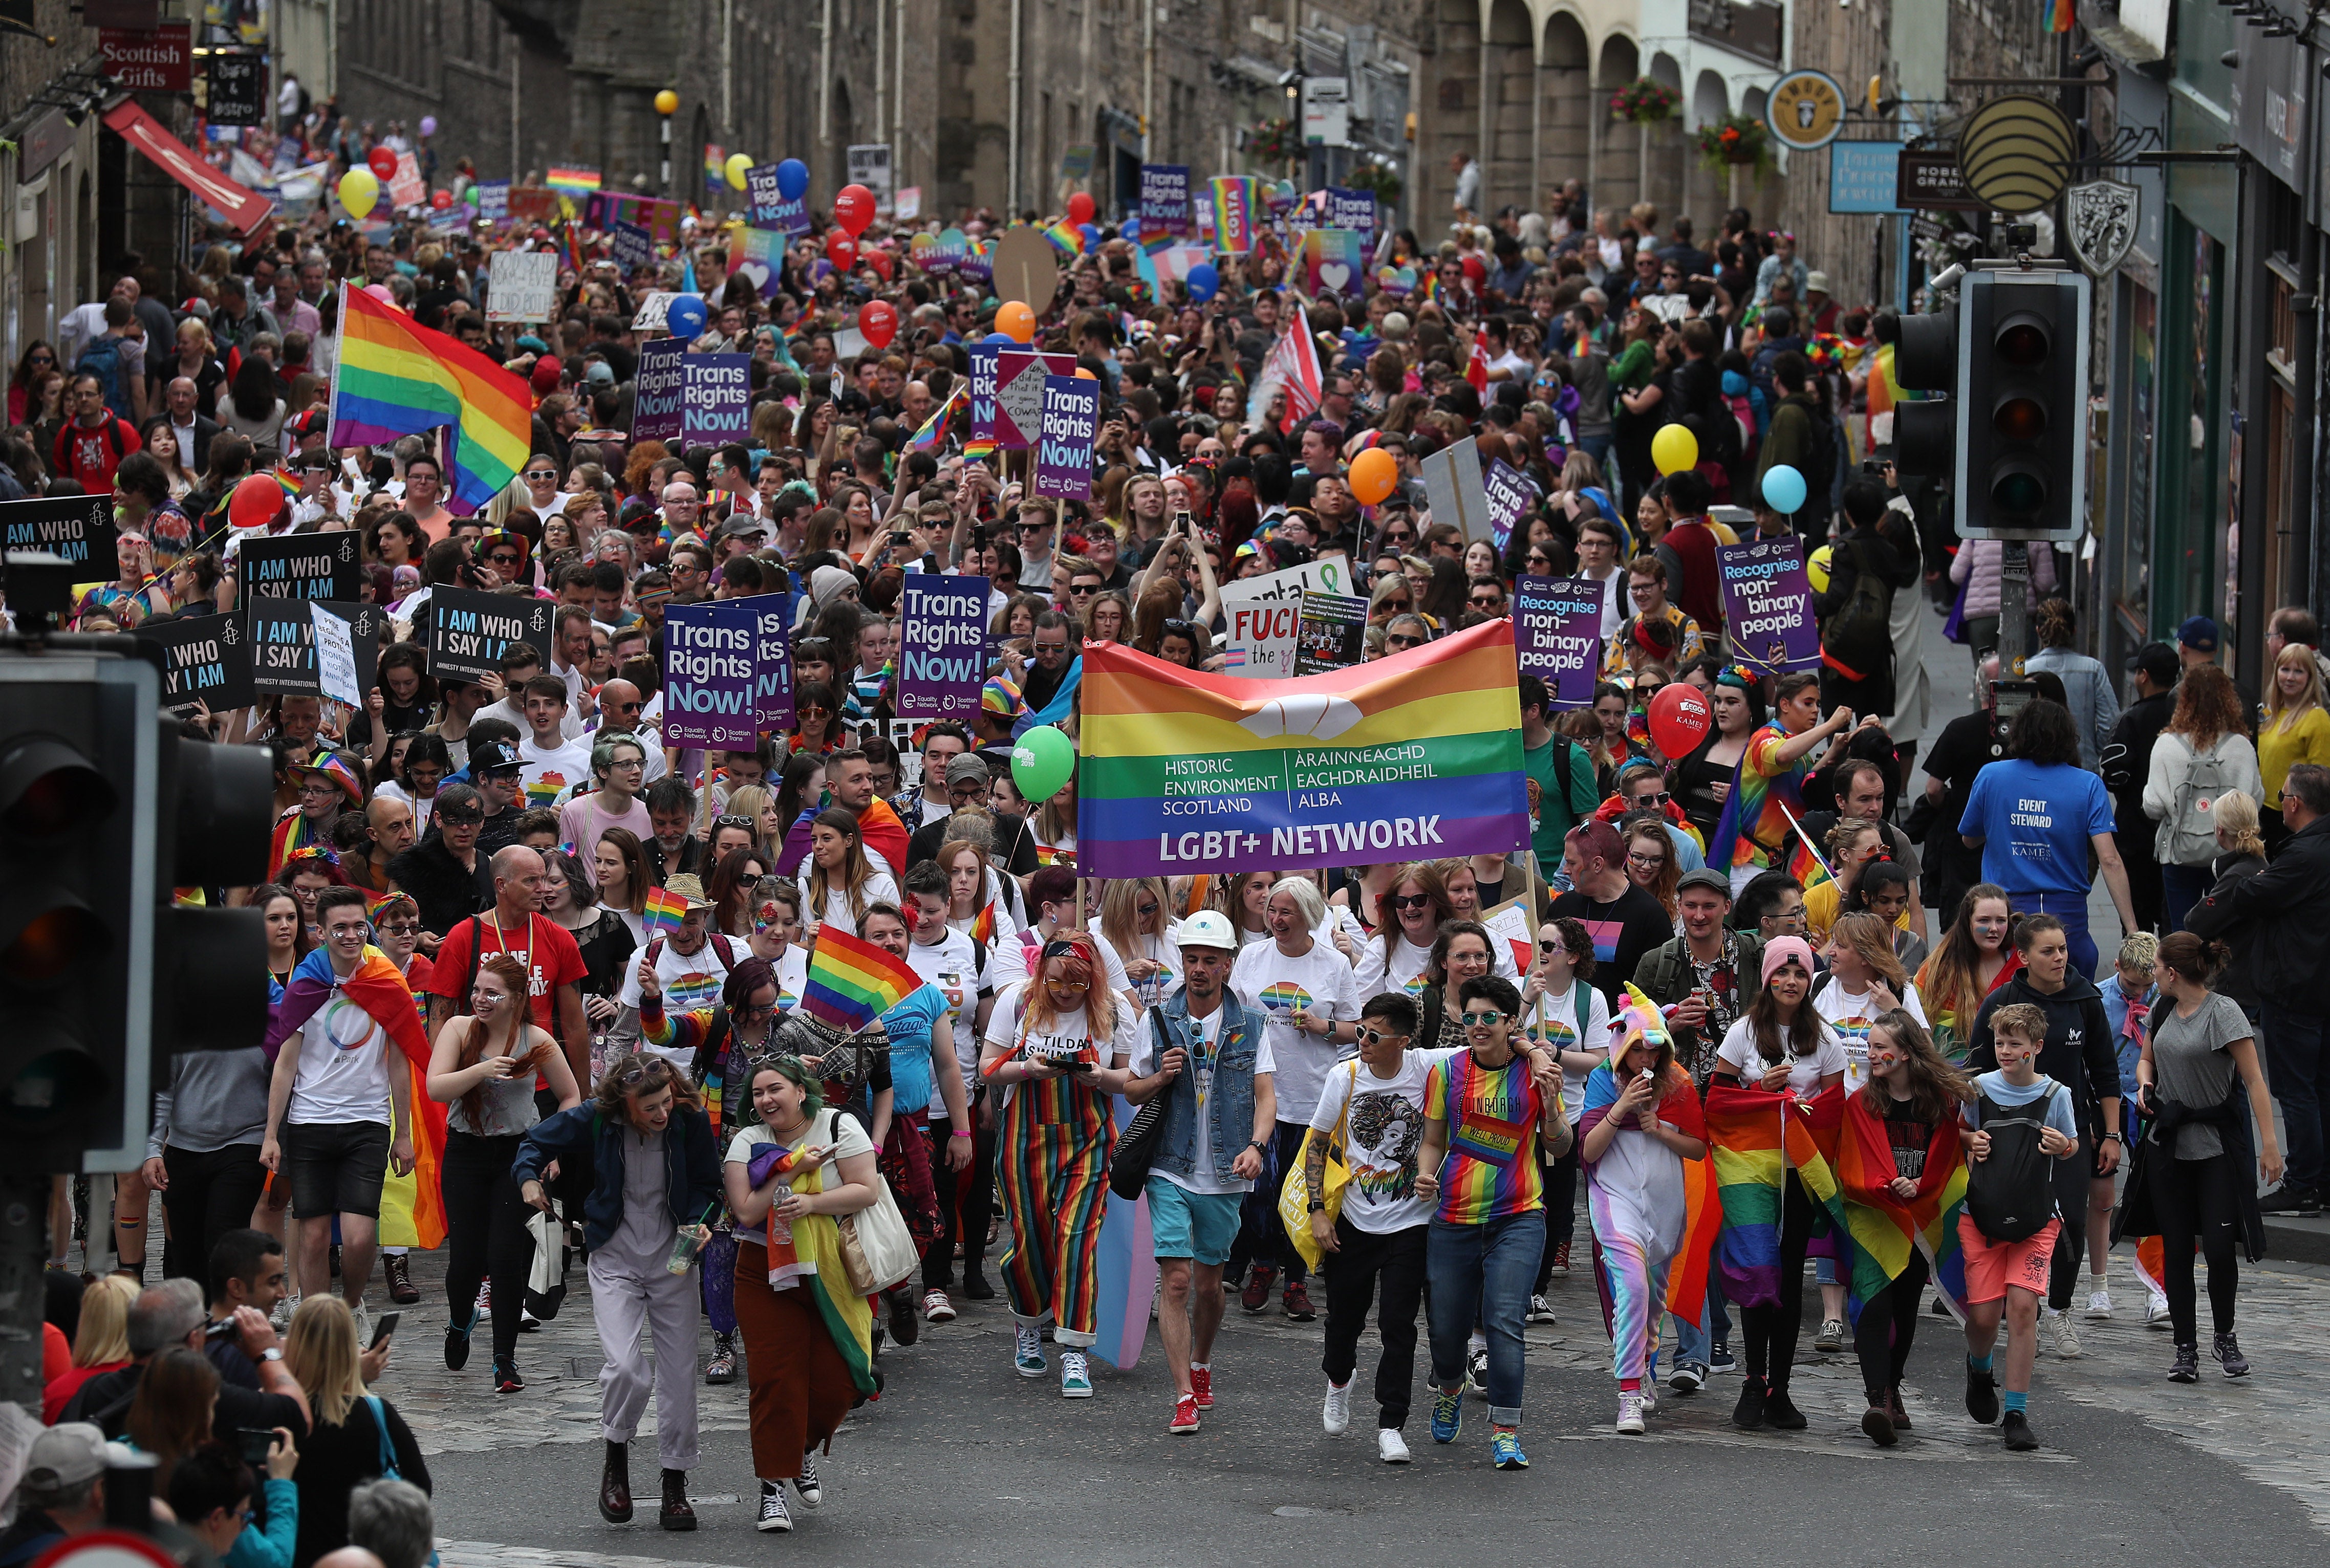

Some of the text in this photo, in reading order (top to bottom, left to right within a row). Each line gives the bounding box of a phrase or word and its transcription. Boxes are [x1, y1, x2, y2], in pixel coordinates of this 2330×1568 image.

[103, 42, 180, 64] Scottish
[119, 67, 166, 88] Gifts
[1141, 170, 1186, 186] Trans
[1917, 166, 1960, 177] ROBE
[1142, 186, 1187, 204] Rights
[1334, 197, 1372, 213] Trans
[2081, 190, 2124, 205] FOCUS
[585, 193, 681, 242] QUEER
[1141, 200, 1187, 219] Now!
[1227, 190, 1241, 238] COSTA
[1334, 213, 1373, 230] Rights
[915, 243, 962, 260] SHINE
[642, 352, 683, 371] Trans
[640, 369, 682, 395] Rights
[683, 364, 745, 383] Trans
[637, 389, 682, 417] Now!
[685, 384, 747, 410] Rights
[1045, 387, 1094, 415] Trans
[685, 407, 748, 431] Now!
[1043, 412, 1093, 442] Rights
[1041, 439, 1092, 470] Now!
[1487, 472, 1523, 511] Trans
[7, 519, 84, 544] AM WHO
[61, 541, 89, 561] AM
[248, 555, 332, 581] I AM WHO
[1724, 558, 1800, 580] Recognise
[259, 581, 290, 598] SAY
[297, 580, 301, 599] I
[307, 577, 333, 599] AM
[1733, 579, 1778, 597] non-
[907, 589, 981, 617] Trans
[1519, 595, 1597, 616] Recognise
[1748, 594, 1806, 614] binary
[438, 607, 523, 641] I AM WHO
[1523, 613, 1570, 629] non-
[1740, 611, 1803, 640] people
[256, 620, 263, 642] I
[268, 621, 297, 644] AM
[667, 620, 750, 650] Trans
[905, 618, 982, 652] Rights
[173, 639, 219, 667] WHO
[344, 639, 350, 647] A
[437, 630, 514, 661] I SAY I A
[1533, 630, 1594, 657] binary
[255, 644, 313, 669] I SAY I
[321, 648, 354, 670] STONEWALL
[1252, 644, 1275, 664] the
[1300, 658, 1315, 666] Well,
[1519, 651, 1584, 673] people
[436, 662, 459, 672] AMNESTY
[669, 648, 752, 684] Rights
[903, 650, 982, 683] Now!
[184, 663, 225, 691] I AM
[254, 677, 318, 688] AMNESTY INTERNATIONAL
[757, 664, 789, 698] w!
[668, 681, 753, 715] Now!
[1684, 703, 1706, 714] AEGON
[1676, 716, 1703, 729] KAMES
[1164, 758, 1234, 776] HISTORIC
[1295, 745, 1426, 768] ÀRAINNEACHD
[1163, 775, 1278, 796] ENVIRONMENT
[1297, 763, 1438, 788] EACHDRAIDHEIL
[1162, 798, 1252, 816] SCOTLAND
[1298, 792, 1343, 809] ALBA
[2018, 799, 2047, 813] EVENT
[2011, 813, 2052, 828] STEWARD
[1159, 814, 1444, 861] LGBT+ NETWORK
[2012, 847, 2051, 857] KAMES
[1491, 913, 1518, 931] ORTH
[527, 980, 549, 996] AY.
[883, 1019, 925, 1038] ritage
[1043, 1036, 1085, 1049] TILDA
[341, 1055, 359, 1063] Park
[1469, 1126, 1510, 1146] WELL PROUD
[1285, 1182, 1306, 1208] PURE
